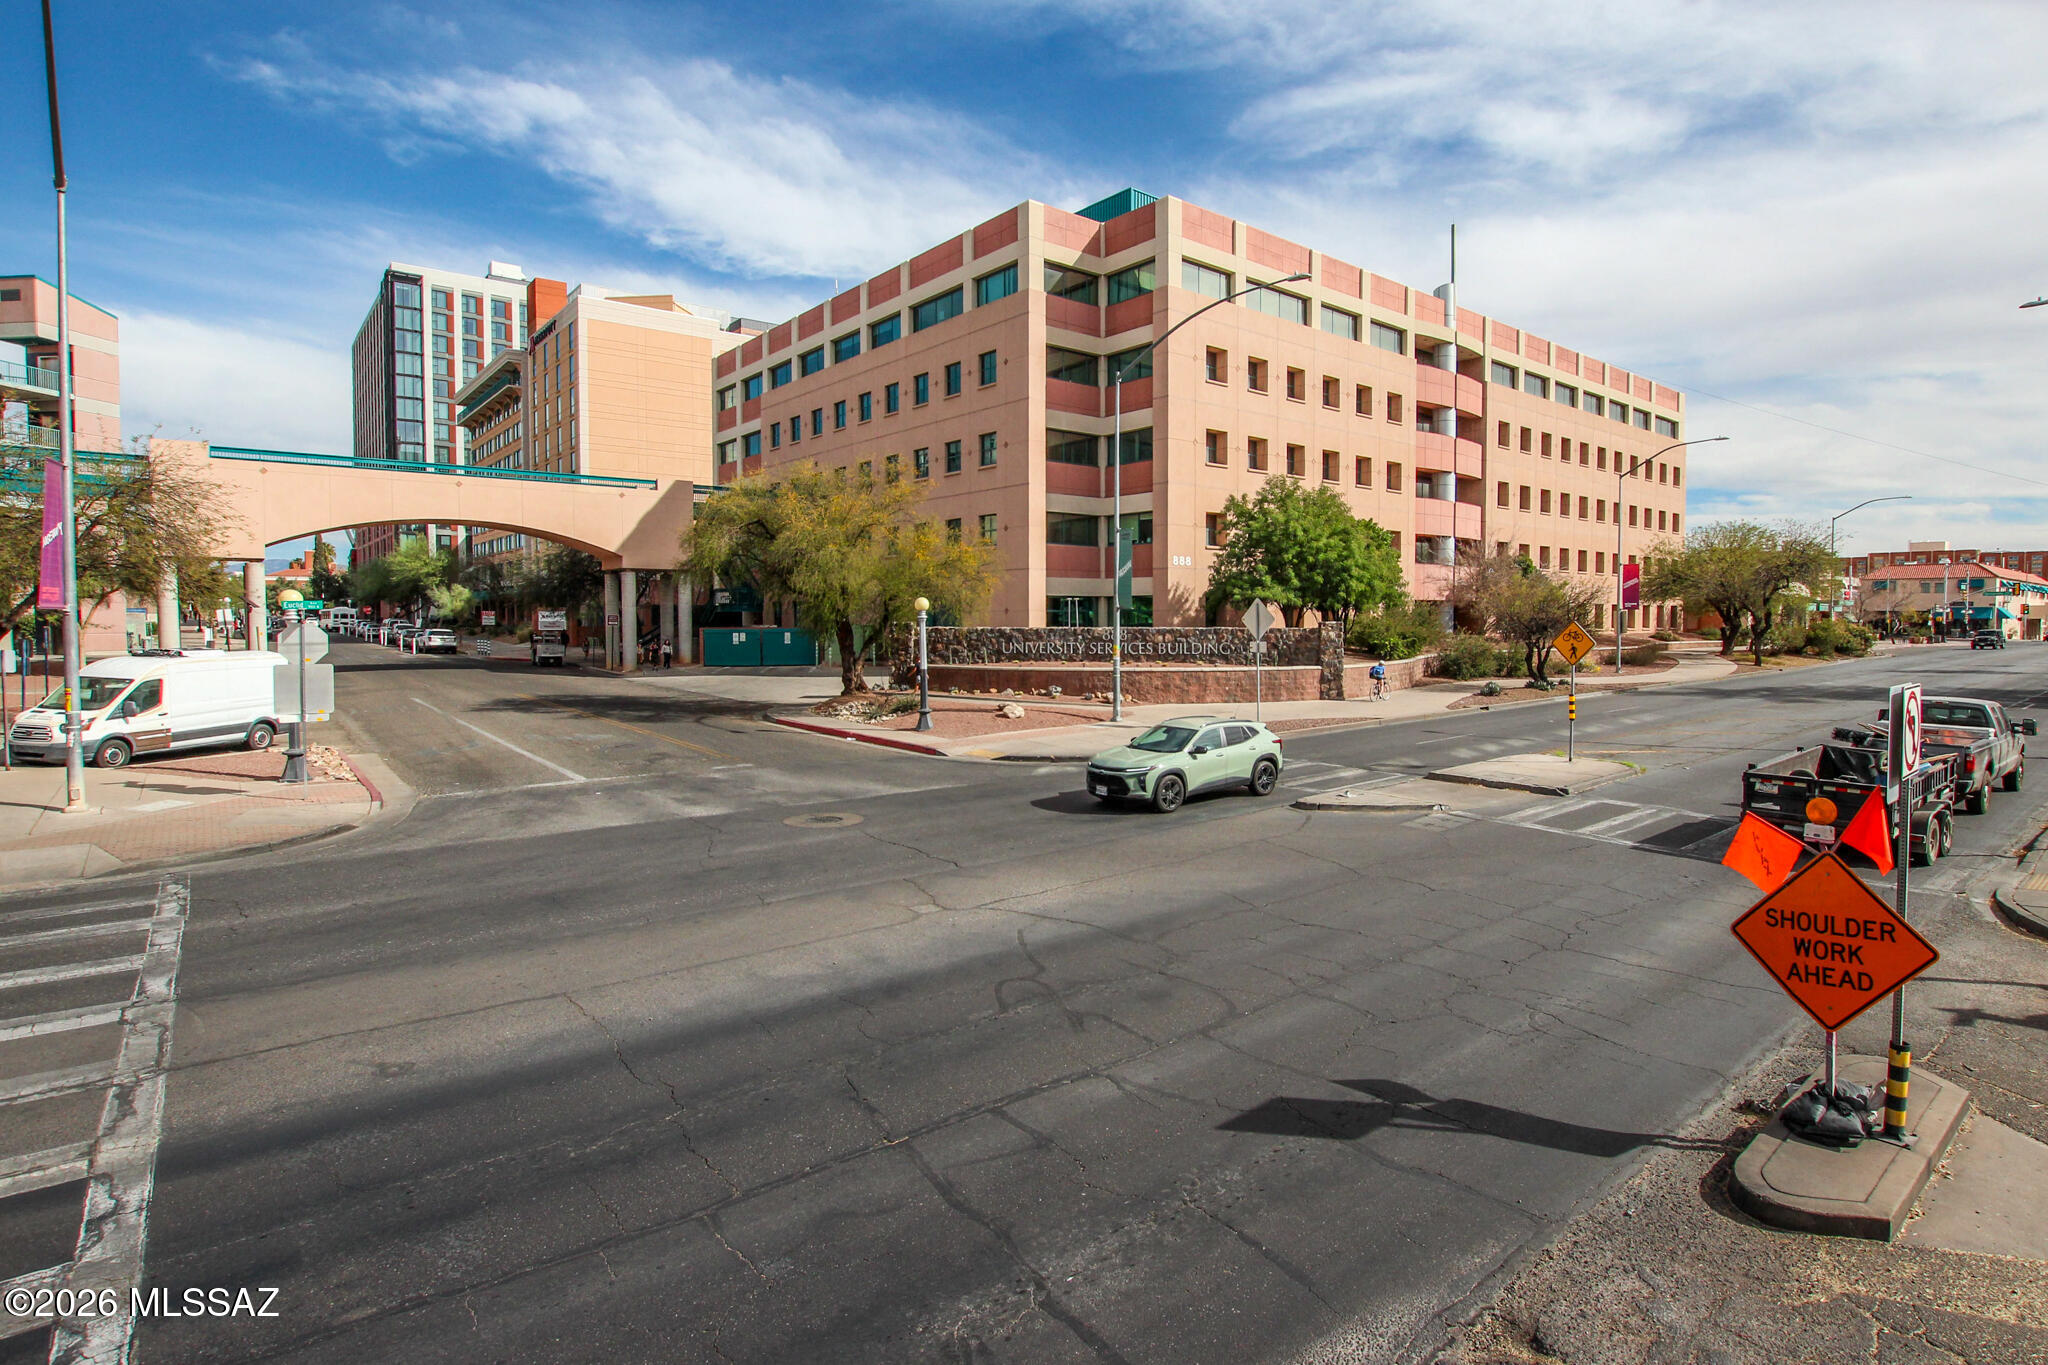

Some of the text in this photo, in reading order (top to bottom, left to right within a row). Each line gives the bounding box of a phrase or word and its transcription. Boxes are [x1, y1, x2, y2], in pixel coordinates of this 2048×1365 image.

[1173, 555, 1192, 566] 888
[1002, 641, 1085, 655] UNIVERSITY
[1158, 642, 1231, 655] BUILDING
[1765, 907, 1897, 943] SHOULDER
[1793, 936, 1864, 966] WORK
[1786, 962, 1874, 992] AHEAD
